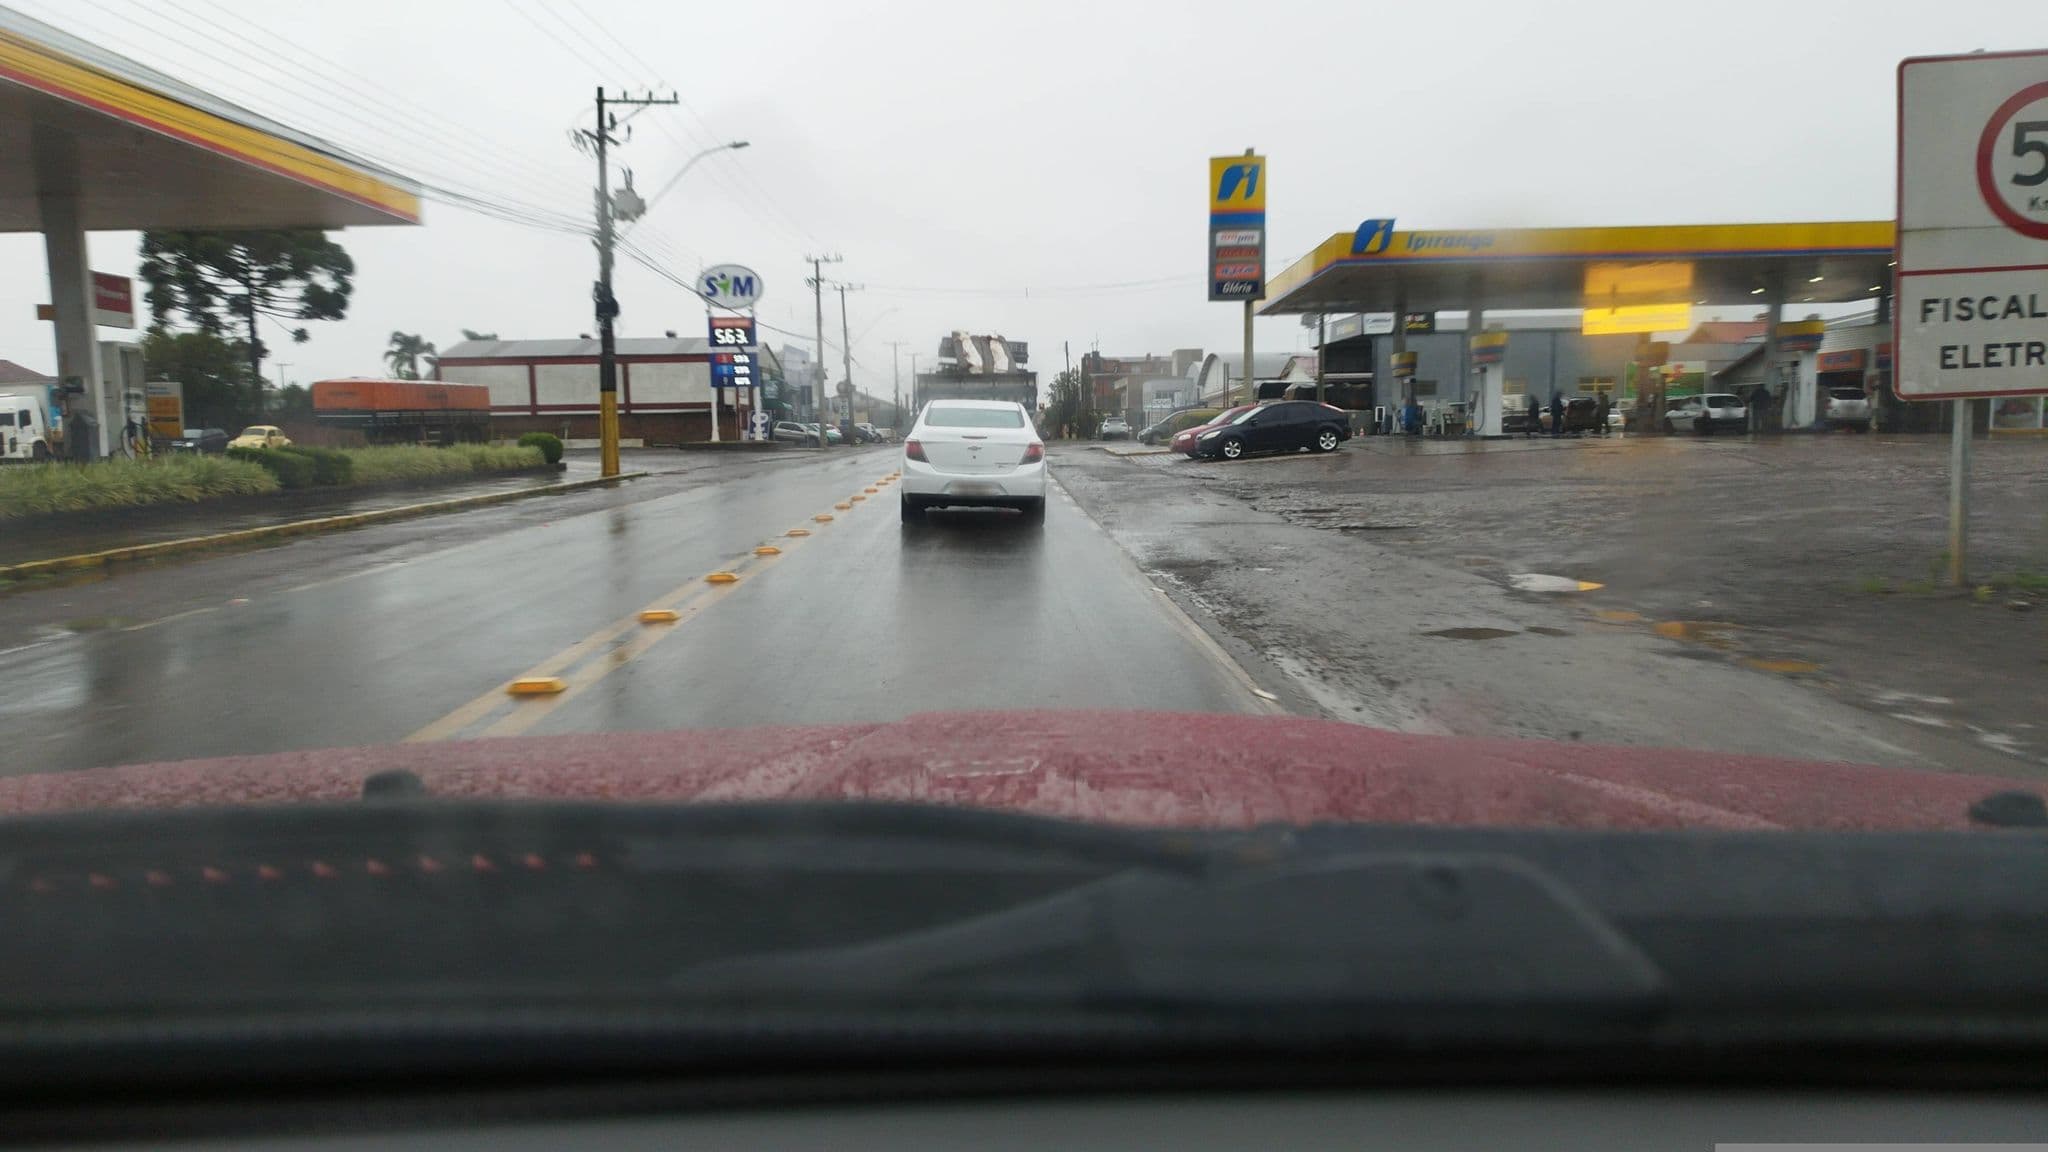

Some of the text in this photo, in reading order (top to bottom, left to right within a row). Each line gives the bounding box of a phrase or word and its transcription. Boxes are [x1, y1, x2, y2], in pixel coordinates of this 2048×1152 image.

[1408, 233, 1494, 250] Ipiranga
[705, 273, 753, 297] SIM
[1222, 281, 1252, 294] Glória
[1920, 294, 2048, 322] FISCAL
[1940, 341, 2046, 369] ELETR
